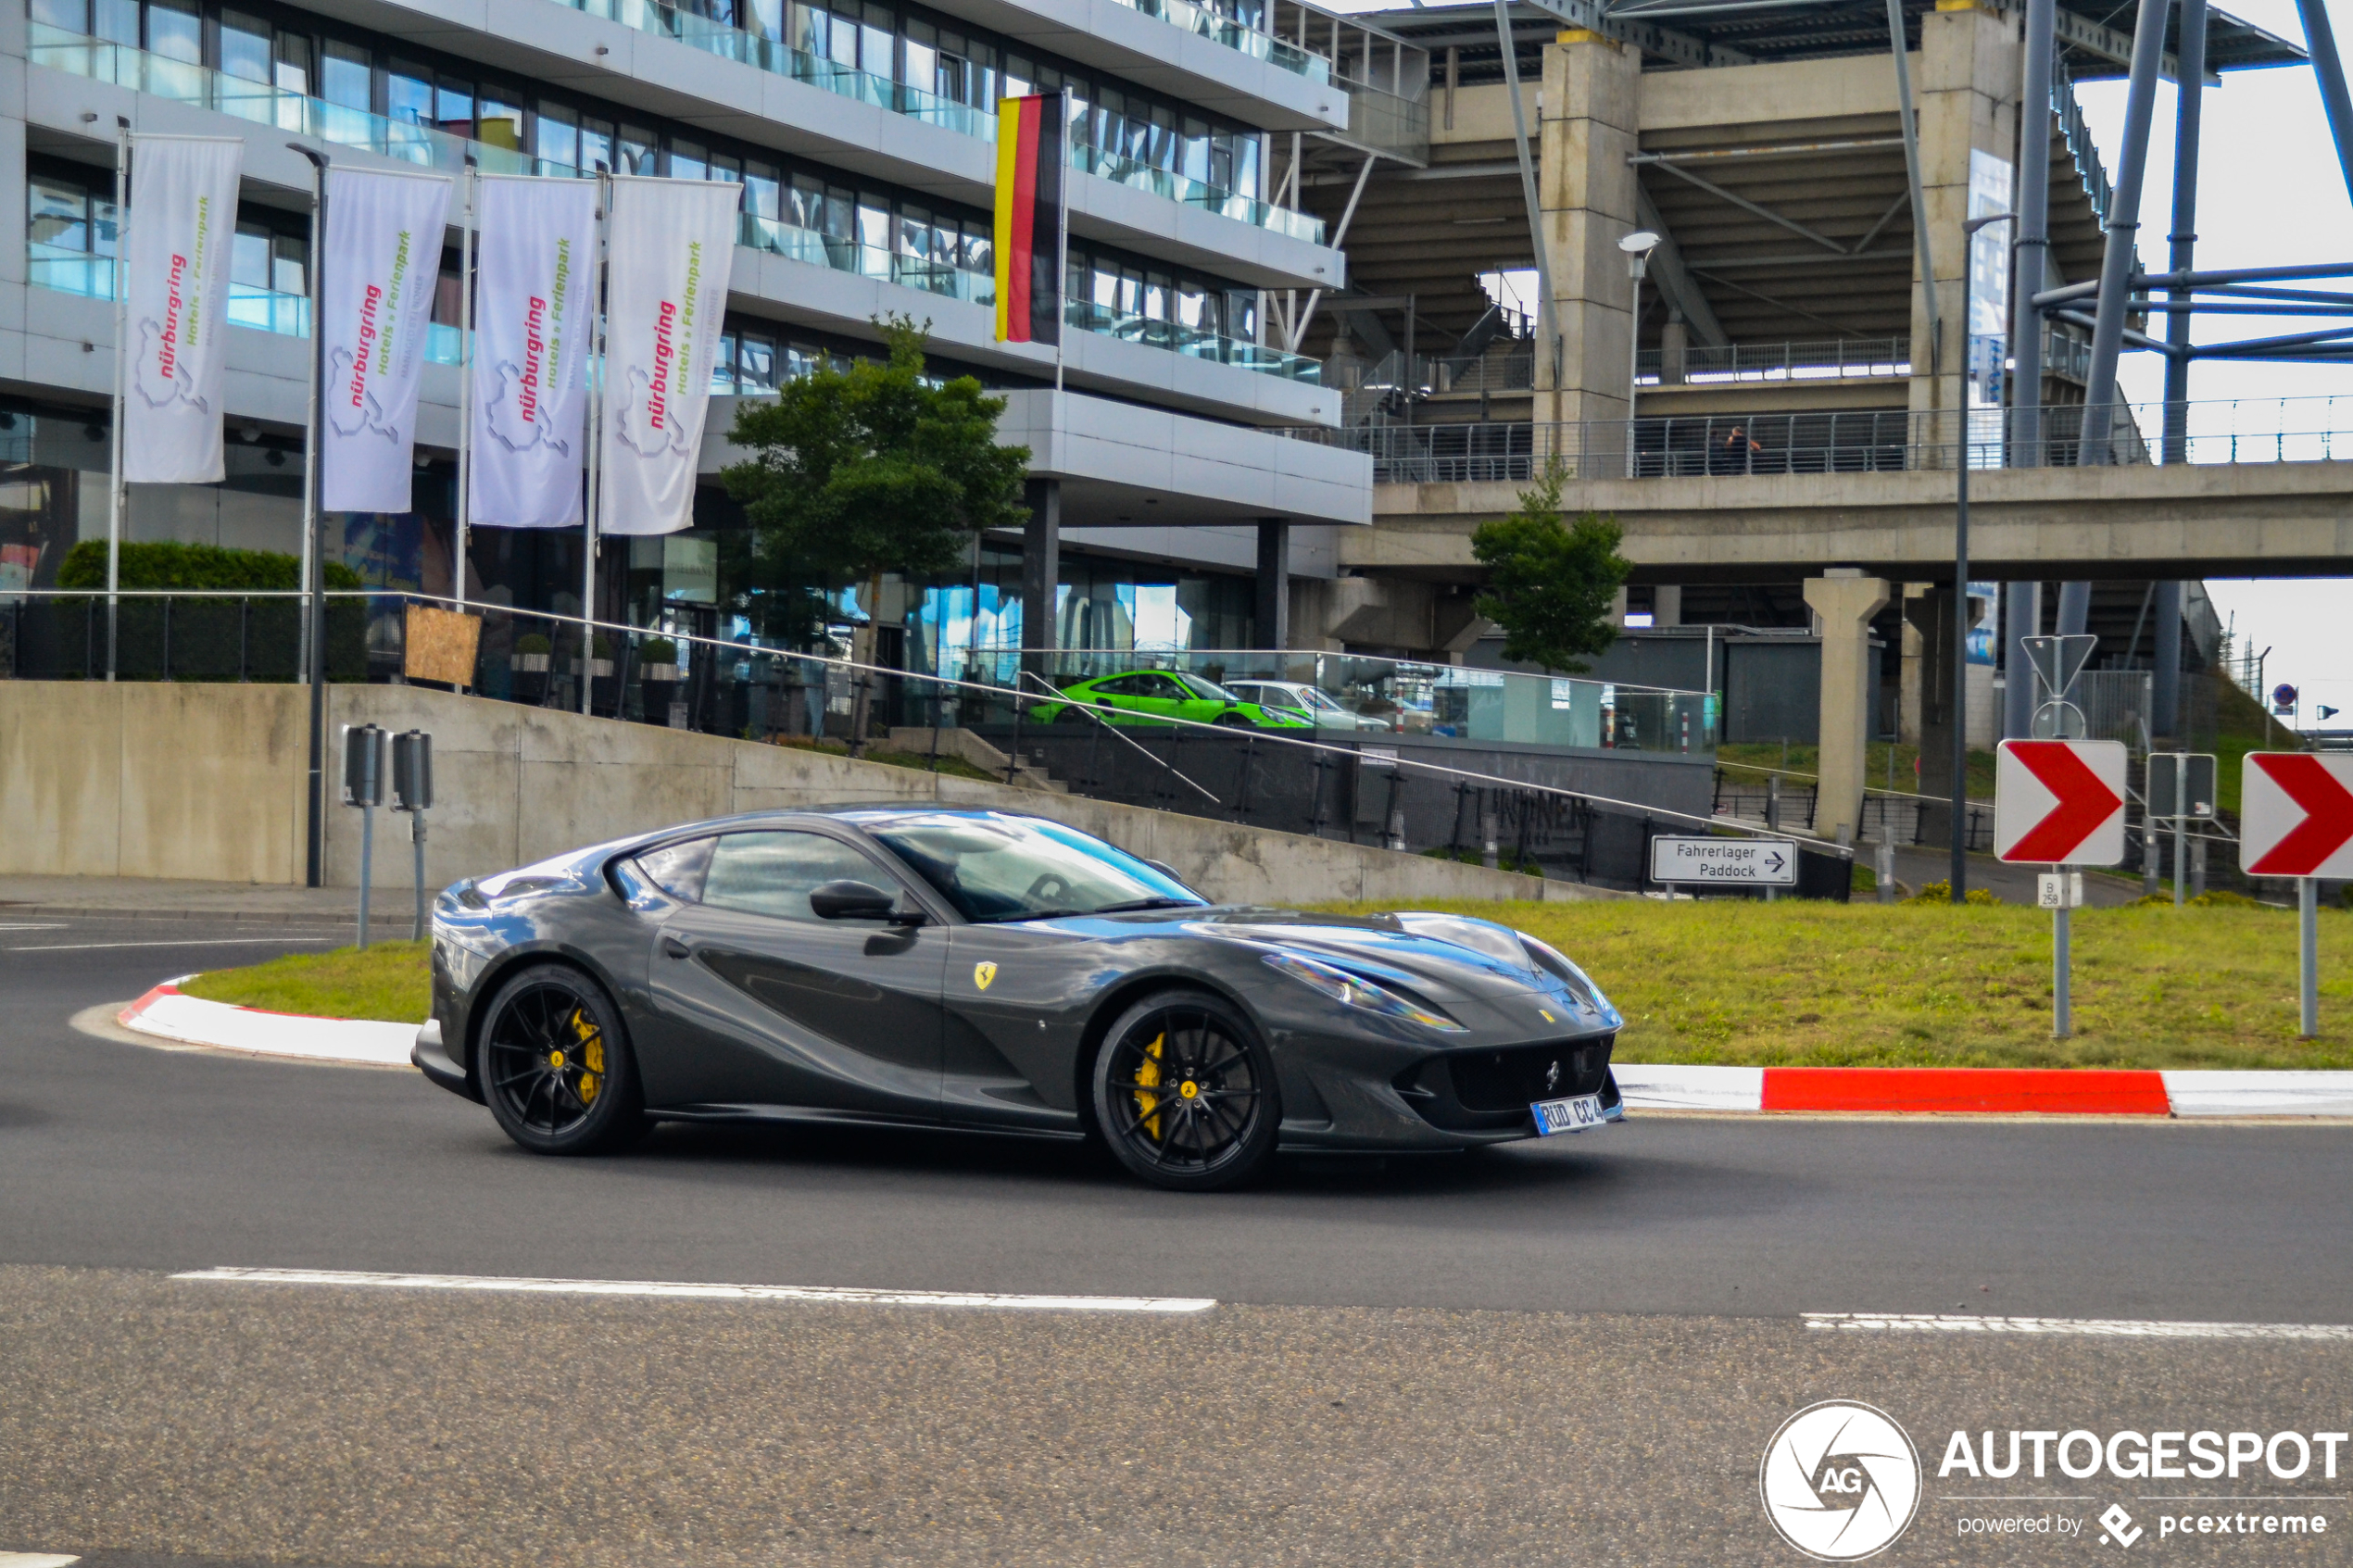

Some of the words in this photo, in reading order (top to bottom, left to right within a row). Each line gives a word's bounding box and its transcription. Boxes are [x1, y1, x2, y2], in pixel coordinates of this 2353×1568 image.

[186, 295, 200, 346] Hotels
[194, 195, 208, 280] Ferienpark
[377, 324, 394, 376] Hotels
[386, 230, 411, 311] Ferienpark
[551, 237, 571, 323] Ferienpark
[682, 241, 701, 327] Ferienpark
[157, 253, 187, 379] nürburgring
[349, 283, 382, 408] nürburgring
[400, 330, 416, 379] MANAGED
[519, 295, 547, 423] nürburgring
[546, 337, 560, 389] Hotels
[648, 300, 676, 430] nürburgring
[676, 343, 691, 396] Hotels
[1677, 844, 1756, 861] Fahrerlager
[1700, 863, 1756, 878] Paddock
[2042, 894, 2058, 905] 258
[2046, 882, 2054, 894] B
[1540, 1103, 1571, 1129] RÜD
[1573, 1099, 1594, 1123] CC
